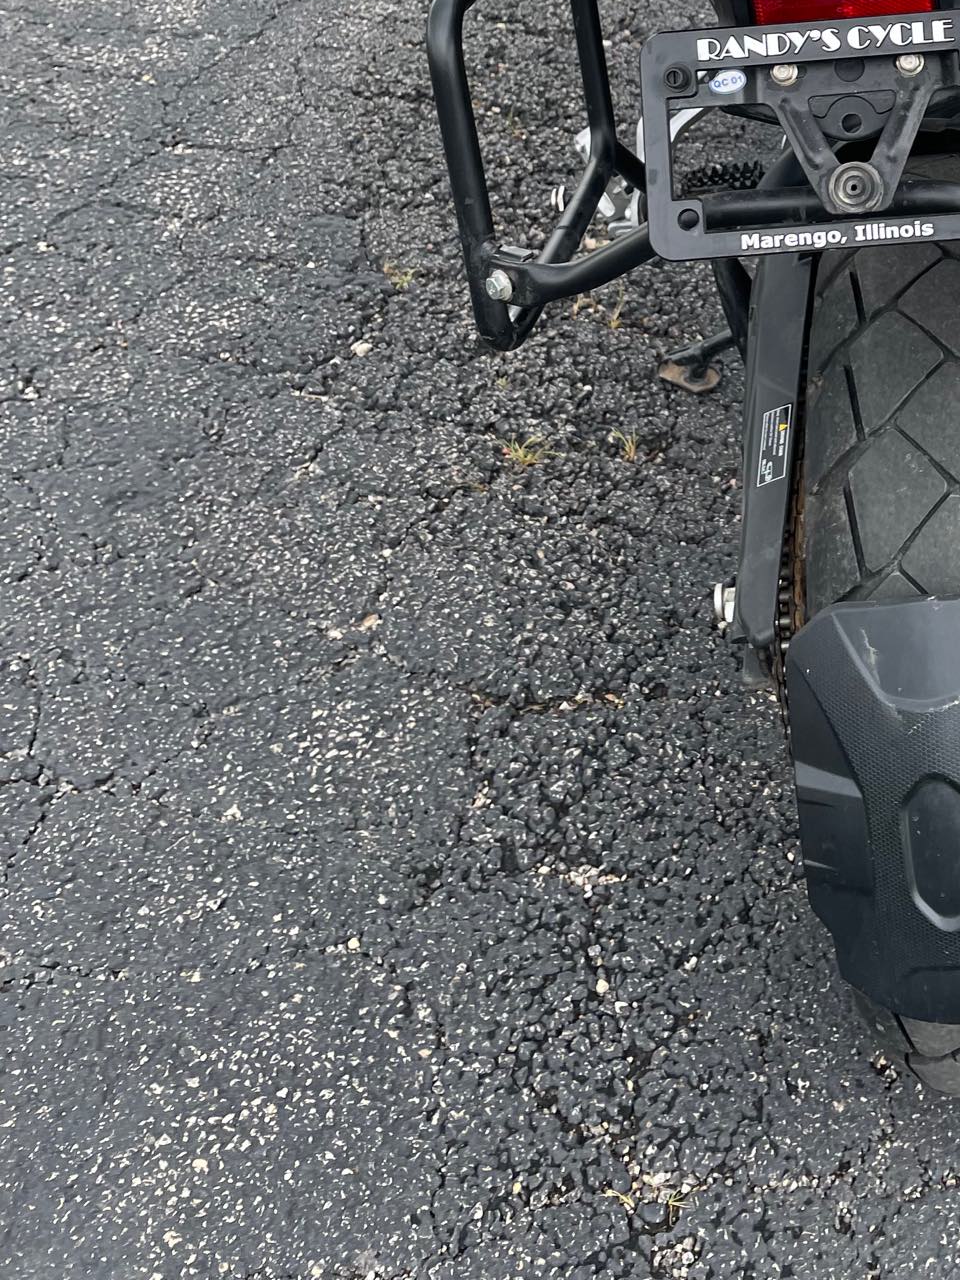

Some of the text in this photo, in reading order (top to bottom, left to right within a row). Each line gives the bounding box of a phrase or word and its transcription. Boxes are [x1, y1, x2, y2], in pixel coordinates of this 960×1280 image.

[696, 19, 954, 61] RANDY'S CYCLE
[713, 78, 728, 89] QC
[740, 221, 934, 250] Marengo, Illinois
